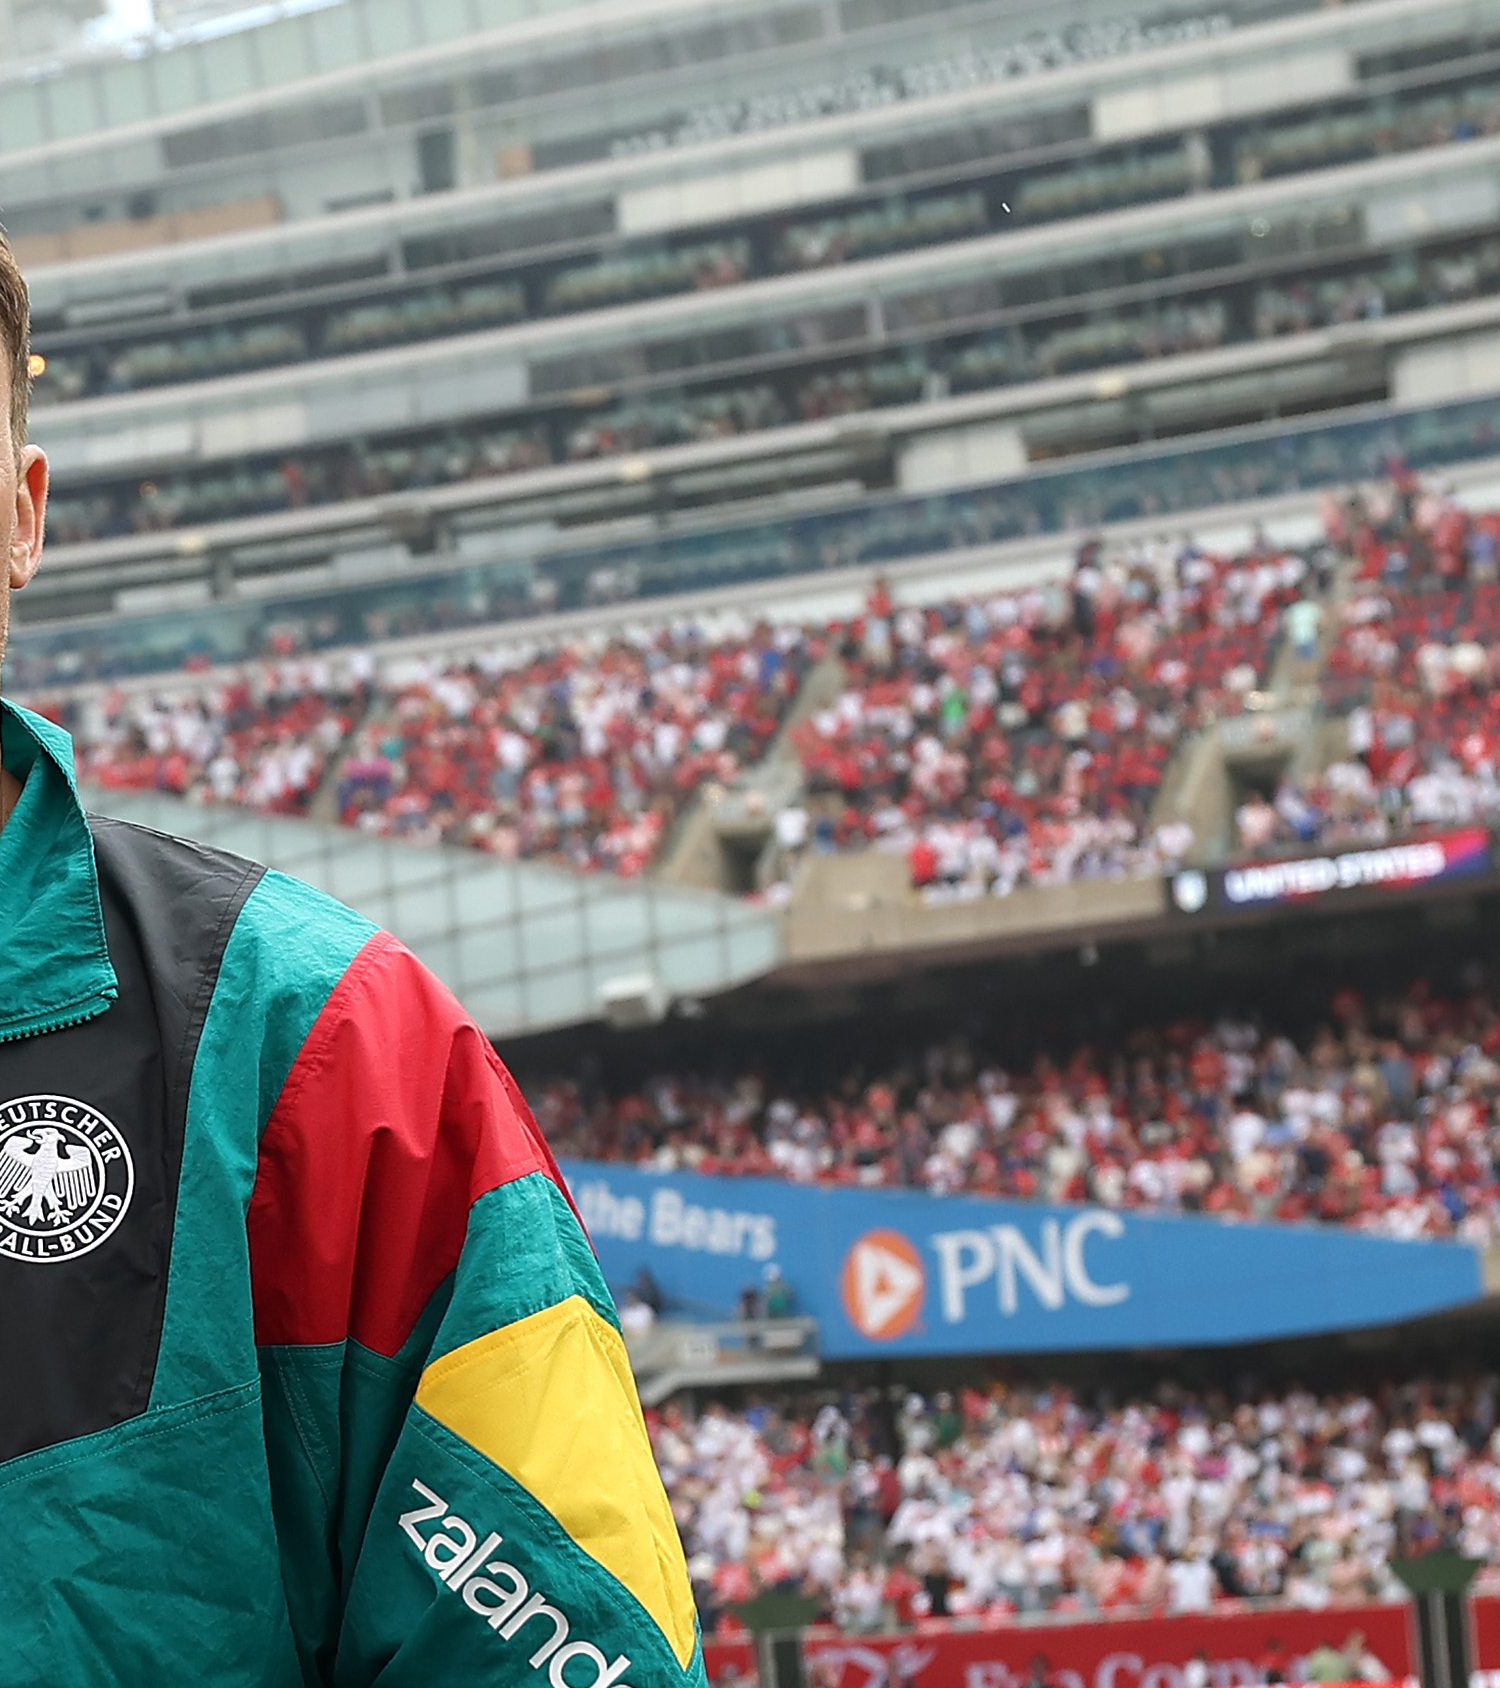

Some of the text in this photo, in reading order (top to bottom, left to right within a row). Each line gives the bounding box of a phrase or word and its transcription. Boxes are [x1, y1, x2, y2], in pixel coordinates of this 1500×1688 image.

[1225, 856, 1338, 902] UNITED
[1334, 841, 1446, 888] STATES
[650, 1187, 776, 1261] Bears
[933, 1210, 1129, 1323] PNC
